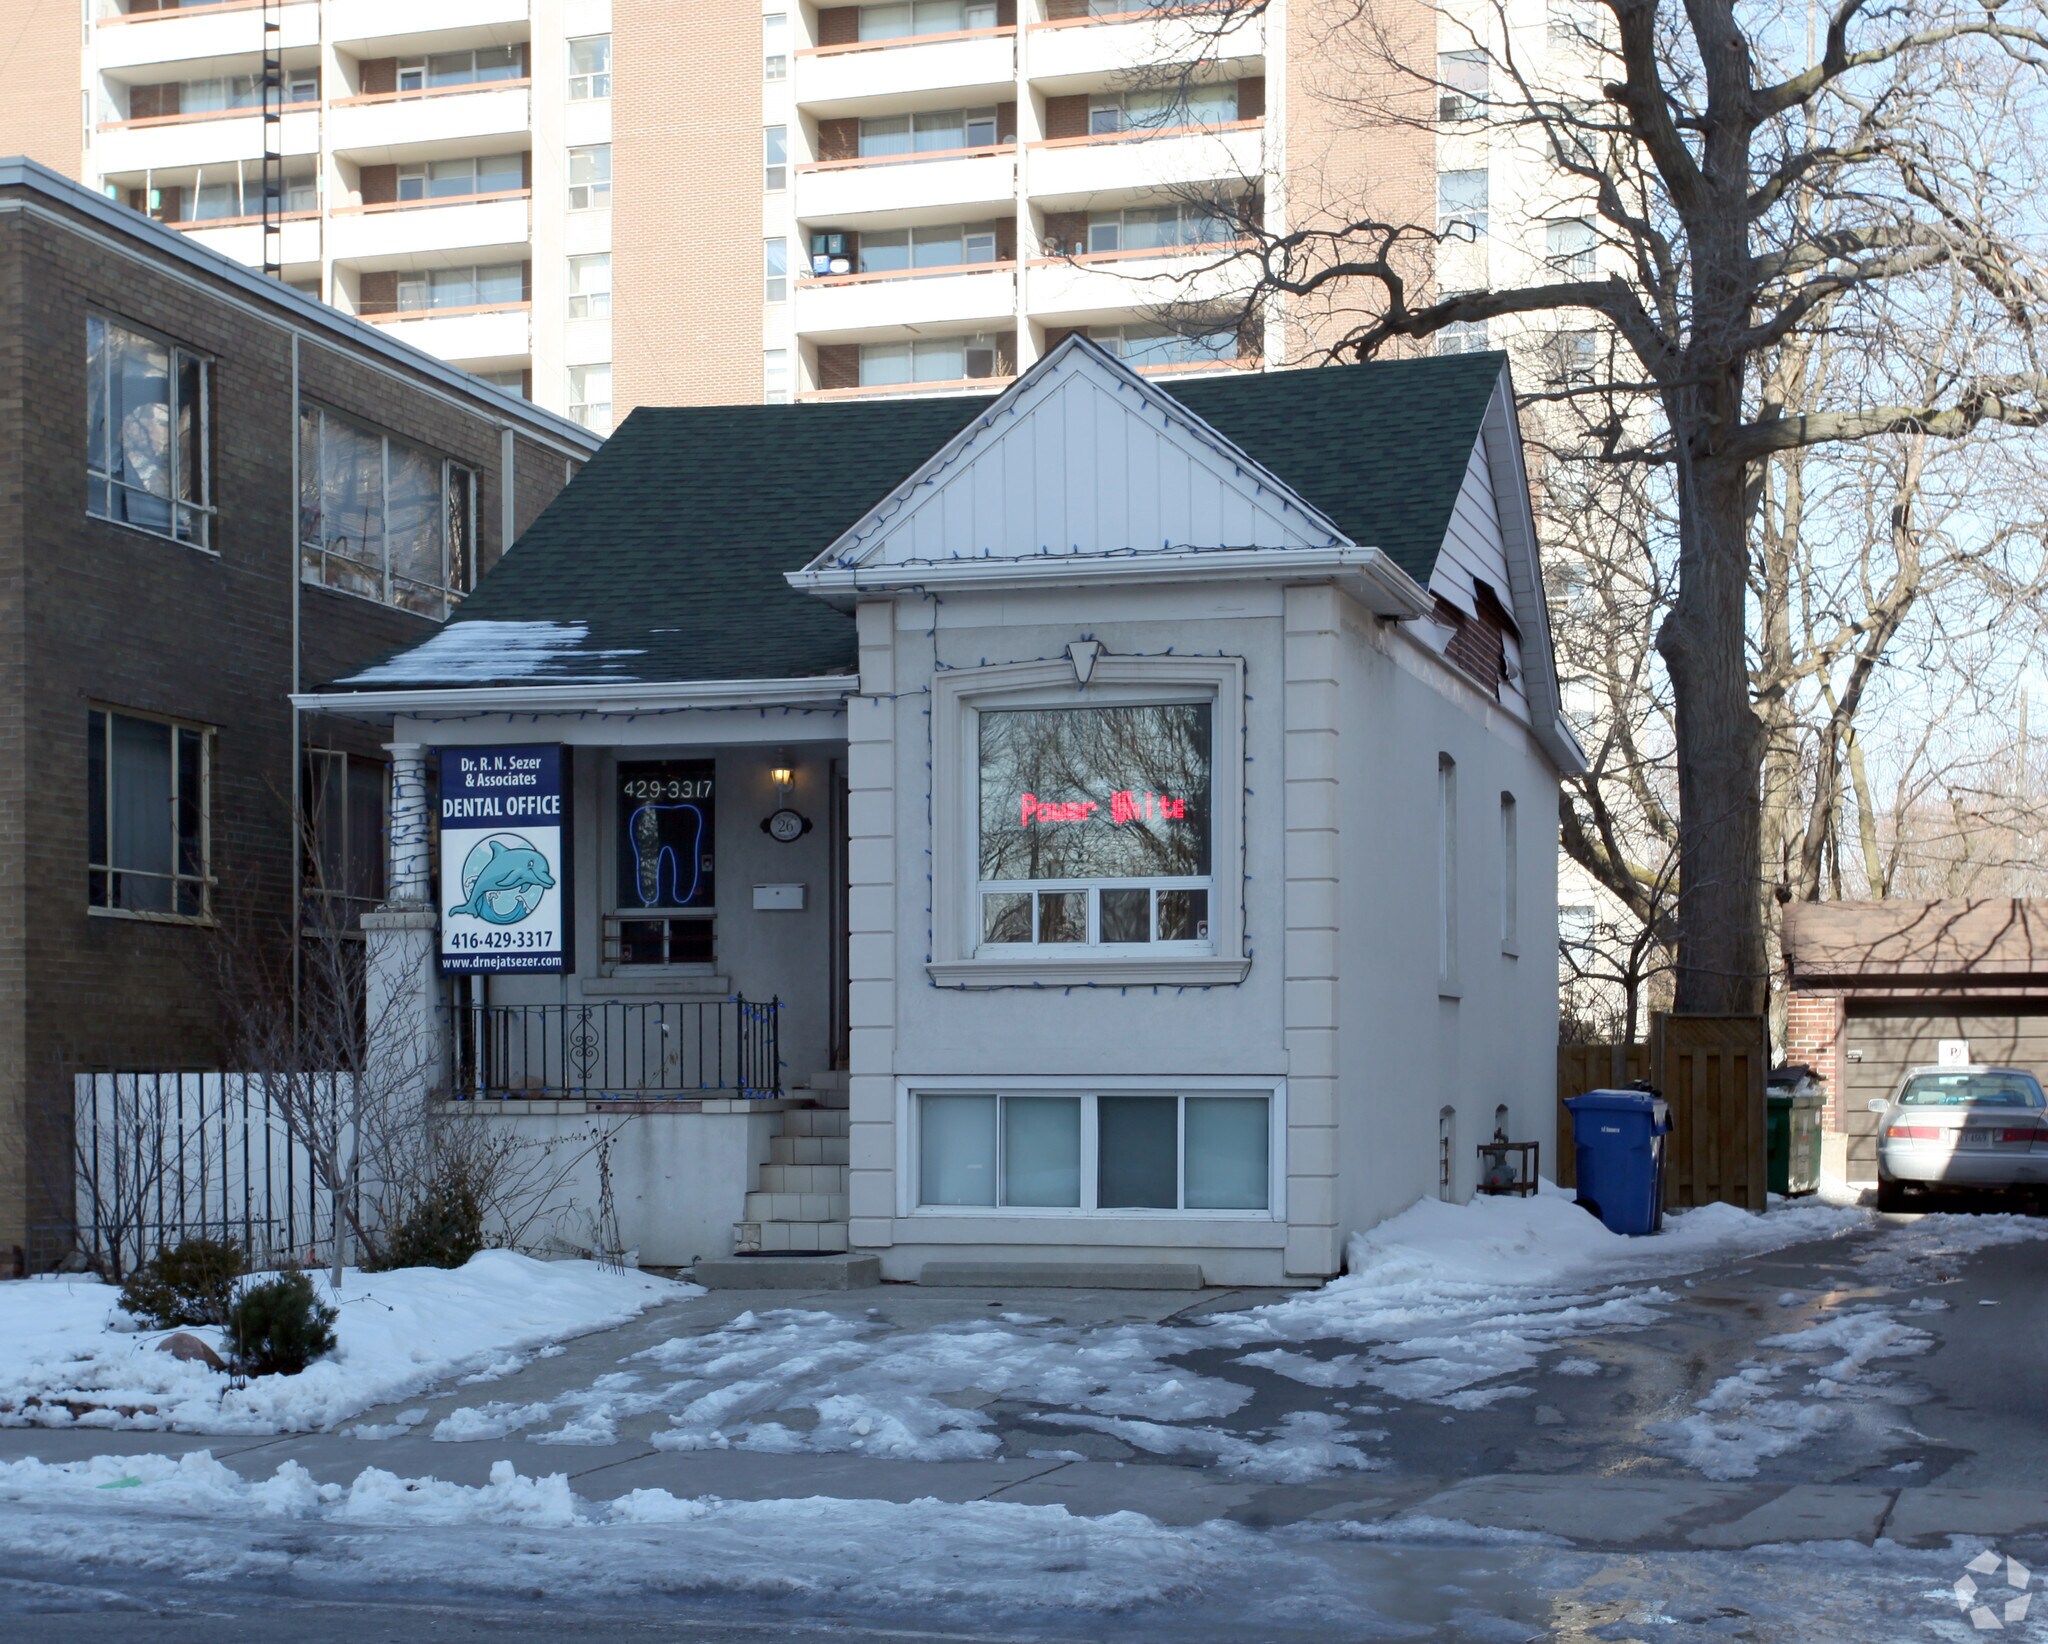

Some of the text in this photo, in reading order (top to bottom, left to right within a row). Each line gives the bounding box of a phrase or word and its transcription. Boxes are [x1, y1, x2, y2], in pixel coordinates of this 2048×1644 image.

[461, 756, 541, 771] Dr. R. N. Sezer
[465, 772, 537, 787] & Associates
[624, 780, 712, 798] 429-3317
[442, 795, 560, 818] DENTAL OFFICE
[1021, 793, 1097, 827] Power
[778, 819, 794, 833] 26
[442, 956, 562, 970] www.drnejatsezer.com
